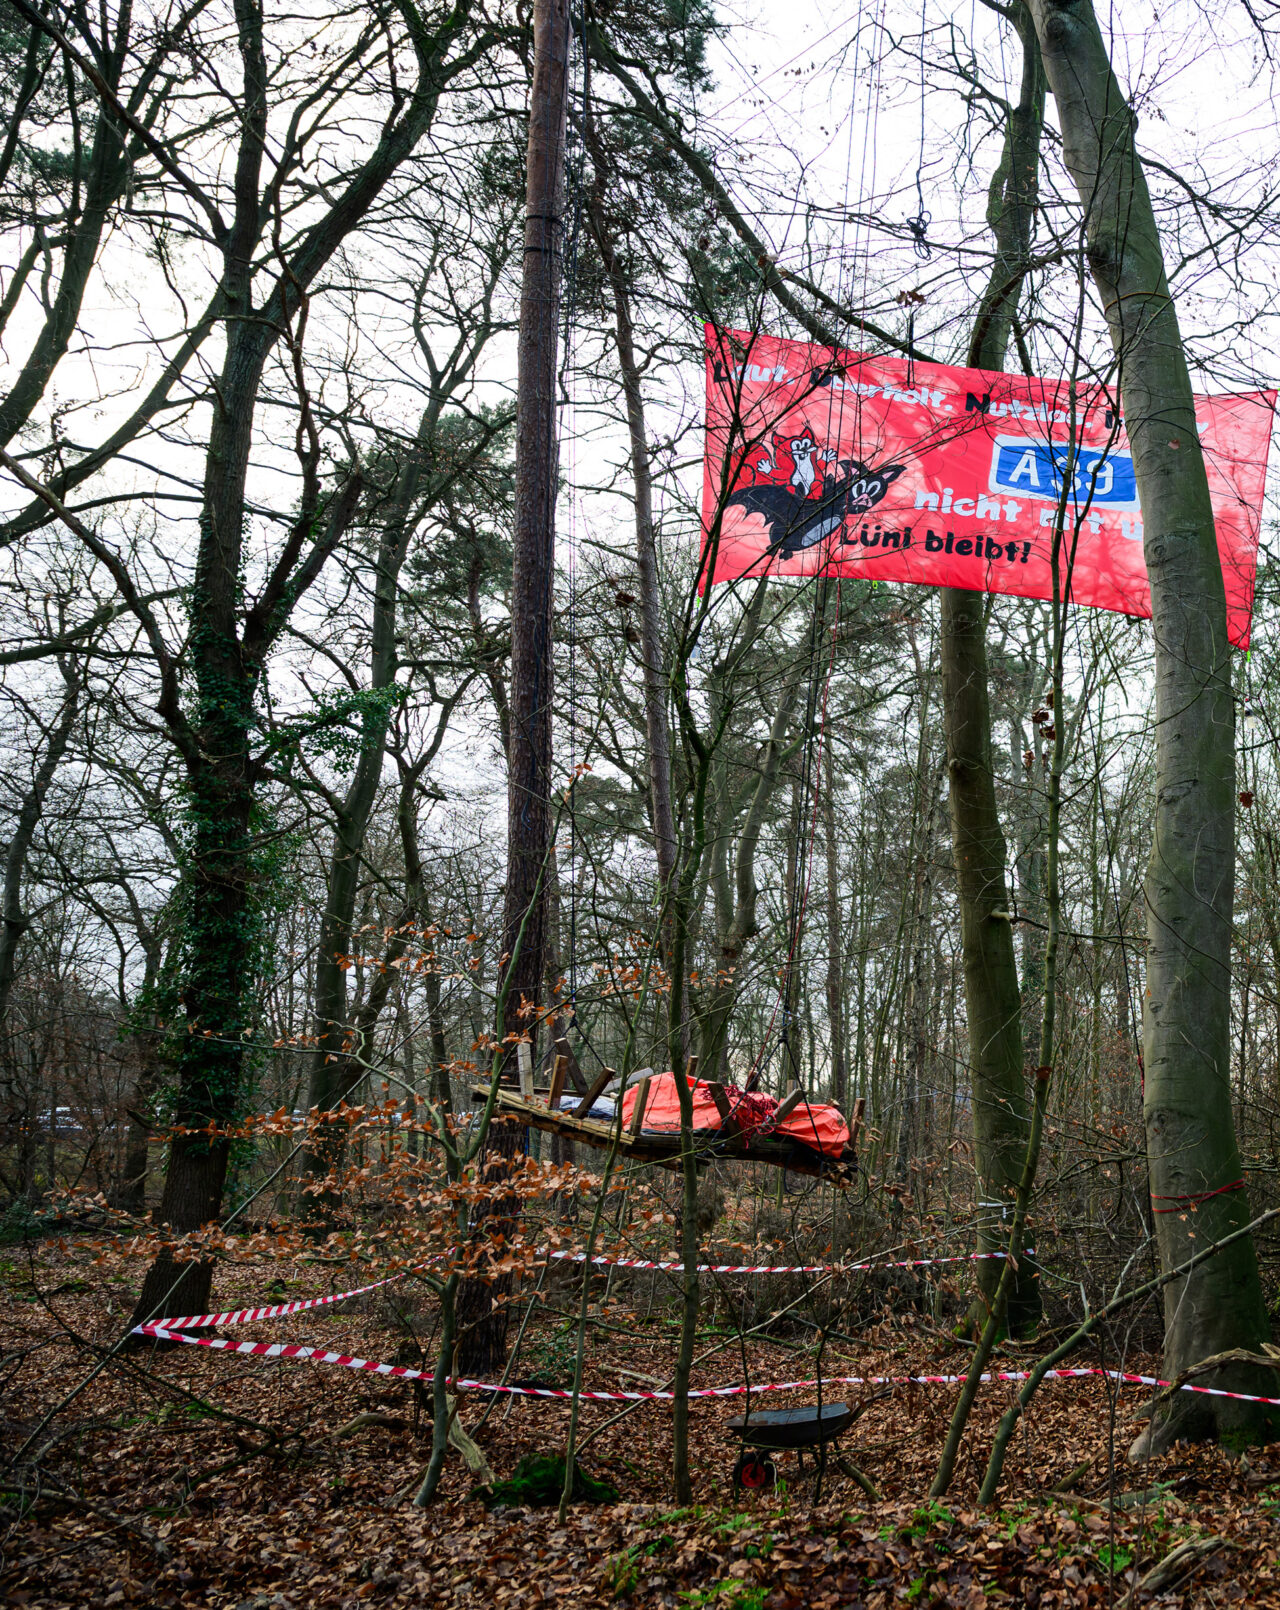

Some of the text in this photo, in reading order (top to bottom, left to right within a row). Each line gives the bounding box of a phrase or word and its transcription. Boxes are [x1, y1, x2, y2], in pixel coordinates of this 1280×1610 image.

[1008, 449, 1114, 495] A 39
[914, 487, 1022, 522] nicht
[840, 523, 1031, 564] Lüni bleibt!
